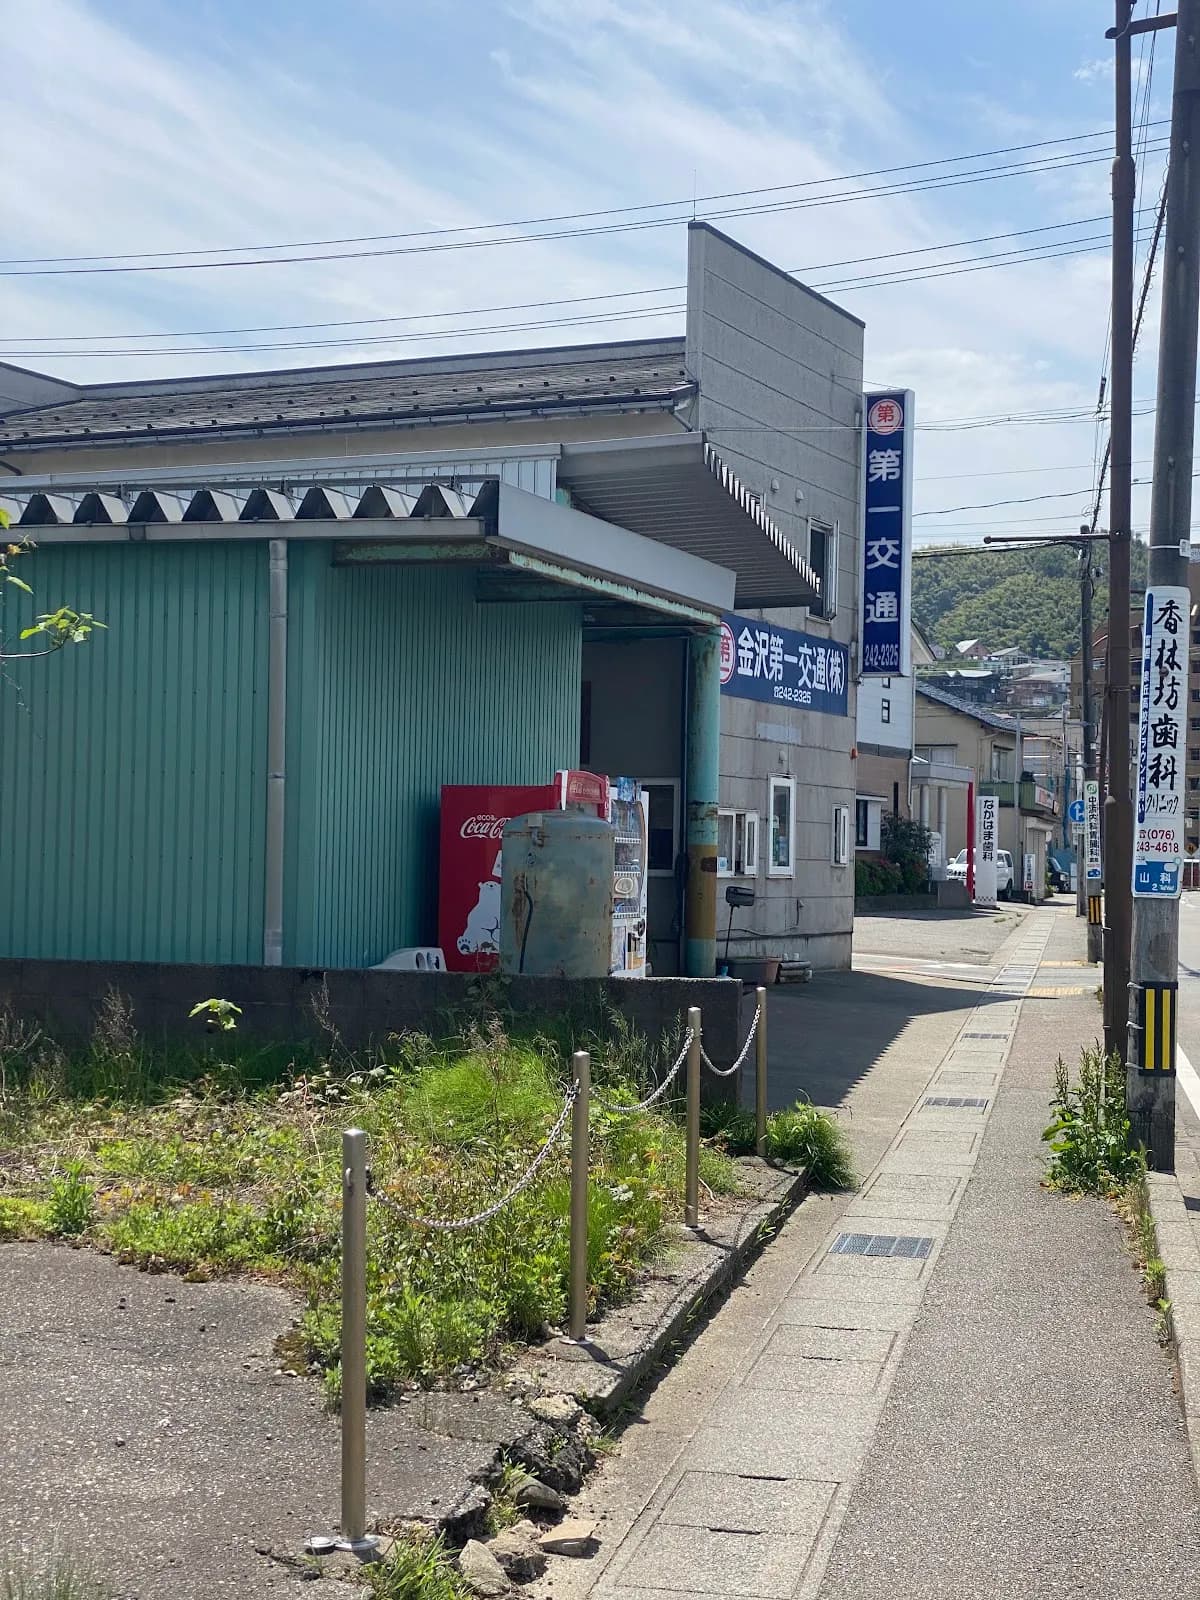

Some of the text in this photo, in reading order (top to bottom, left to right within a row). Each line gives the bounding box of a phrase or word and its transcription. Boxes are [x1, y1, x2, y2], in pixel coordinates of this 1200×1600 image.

[866, 449, 902, 623] 第一交通
[737, 626, 845, 696] 金沢第一交通(株)
[1147, 599, 1184, 791] 香林坊歯科
[982, 799, 994, 862] なかはま歯科
[1146, 794, 1179, 816] クリニック
[1136, 841, 1179, 853] 243-4618
